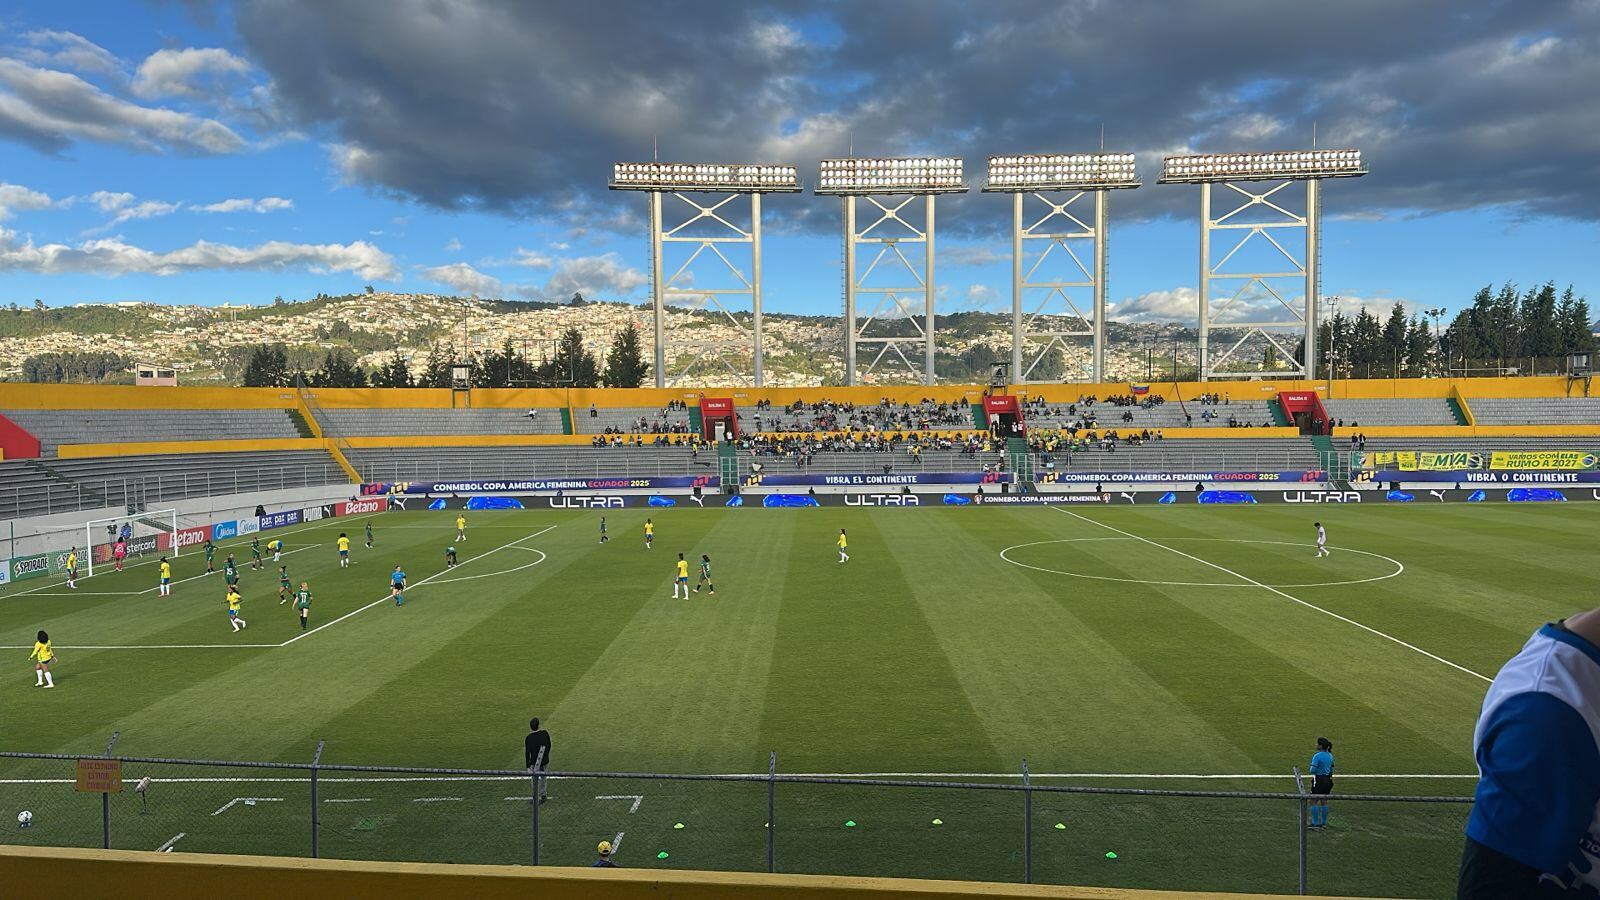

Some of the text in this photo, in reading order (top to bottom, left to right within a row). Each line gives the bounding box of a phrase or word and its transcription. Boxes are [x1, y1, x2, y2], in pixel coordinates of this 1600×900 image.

[1506, 460, 1541, 468] RUMO
[1551, 459, 1577, 467] 2027
[825, 475, 918, 484] VIBRA EL CONTINENTE
[1135, 473, 1172, 481] AMERICA
[1172, 473, 1213, 481] FEMENINA
[1467, 473, 1578, 482] VIBRA O CONTINENTE
[483, 482, 507, 490] COPA
[507, 481, 546, 489] AMERICA
[547, 481, 587, 489] FEMENINA
[588, 480, 630, 488] ECUADOR
[630, 479, 650, 487] 2025
[549, 496, 625, 508] ULTRA
[844, 494, 919, 506] ULTRA
[1283, 491, 1361, 503] ULTRA
[345, 501, 379, 515] Betano
[303, 507, 323, 522] PUMA
[19, 557, 48, 573] SPORADE
